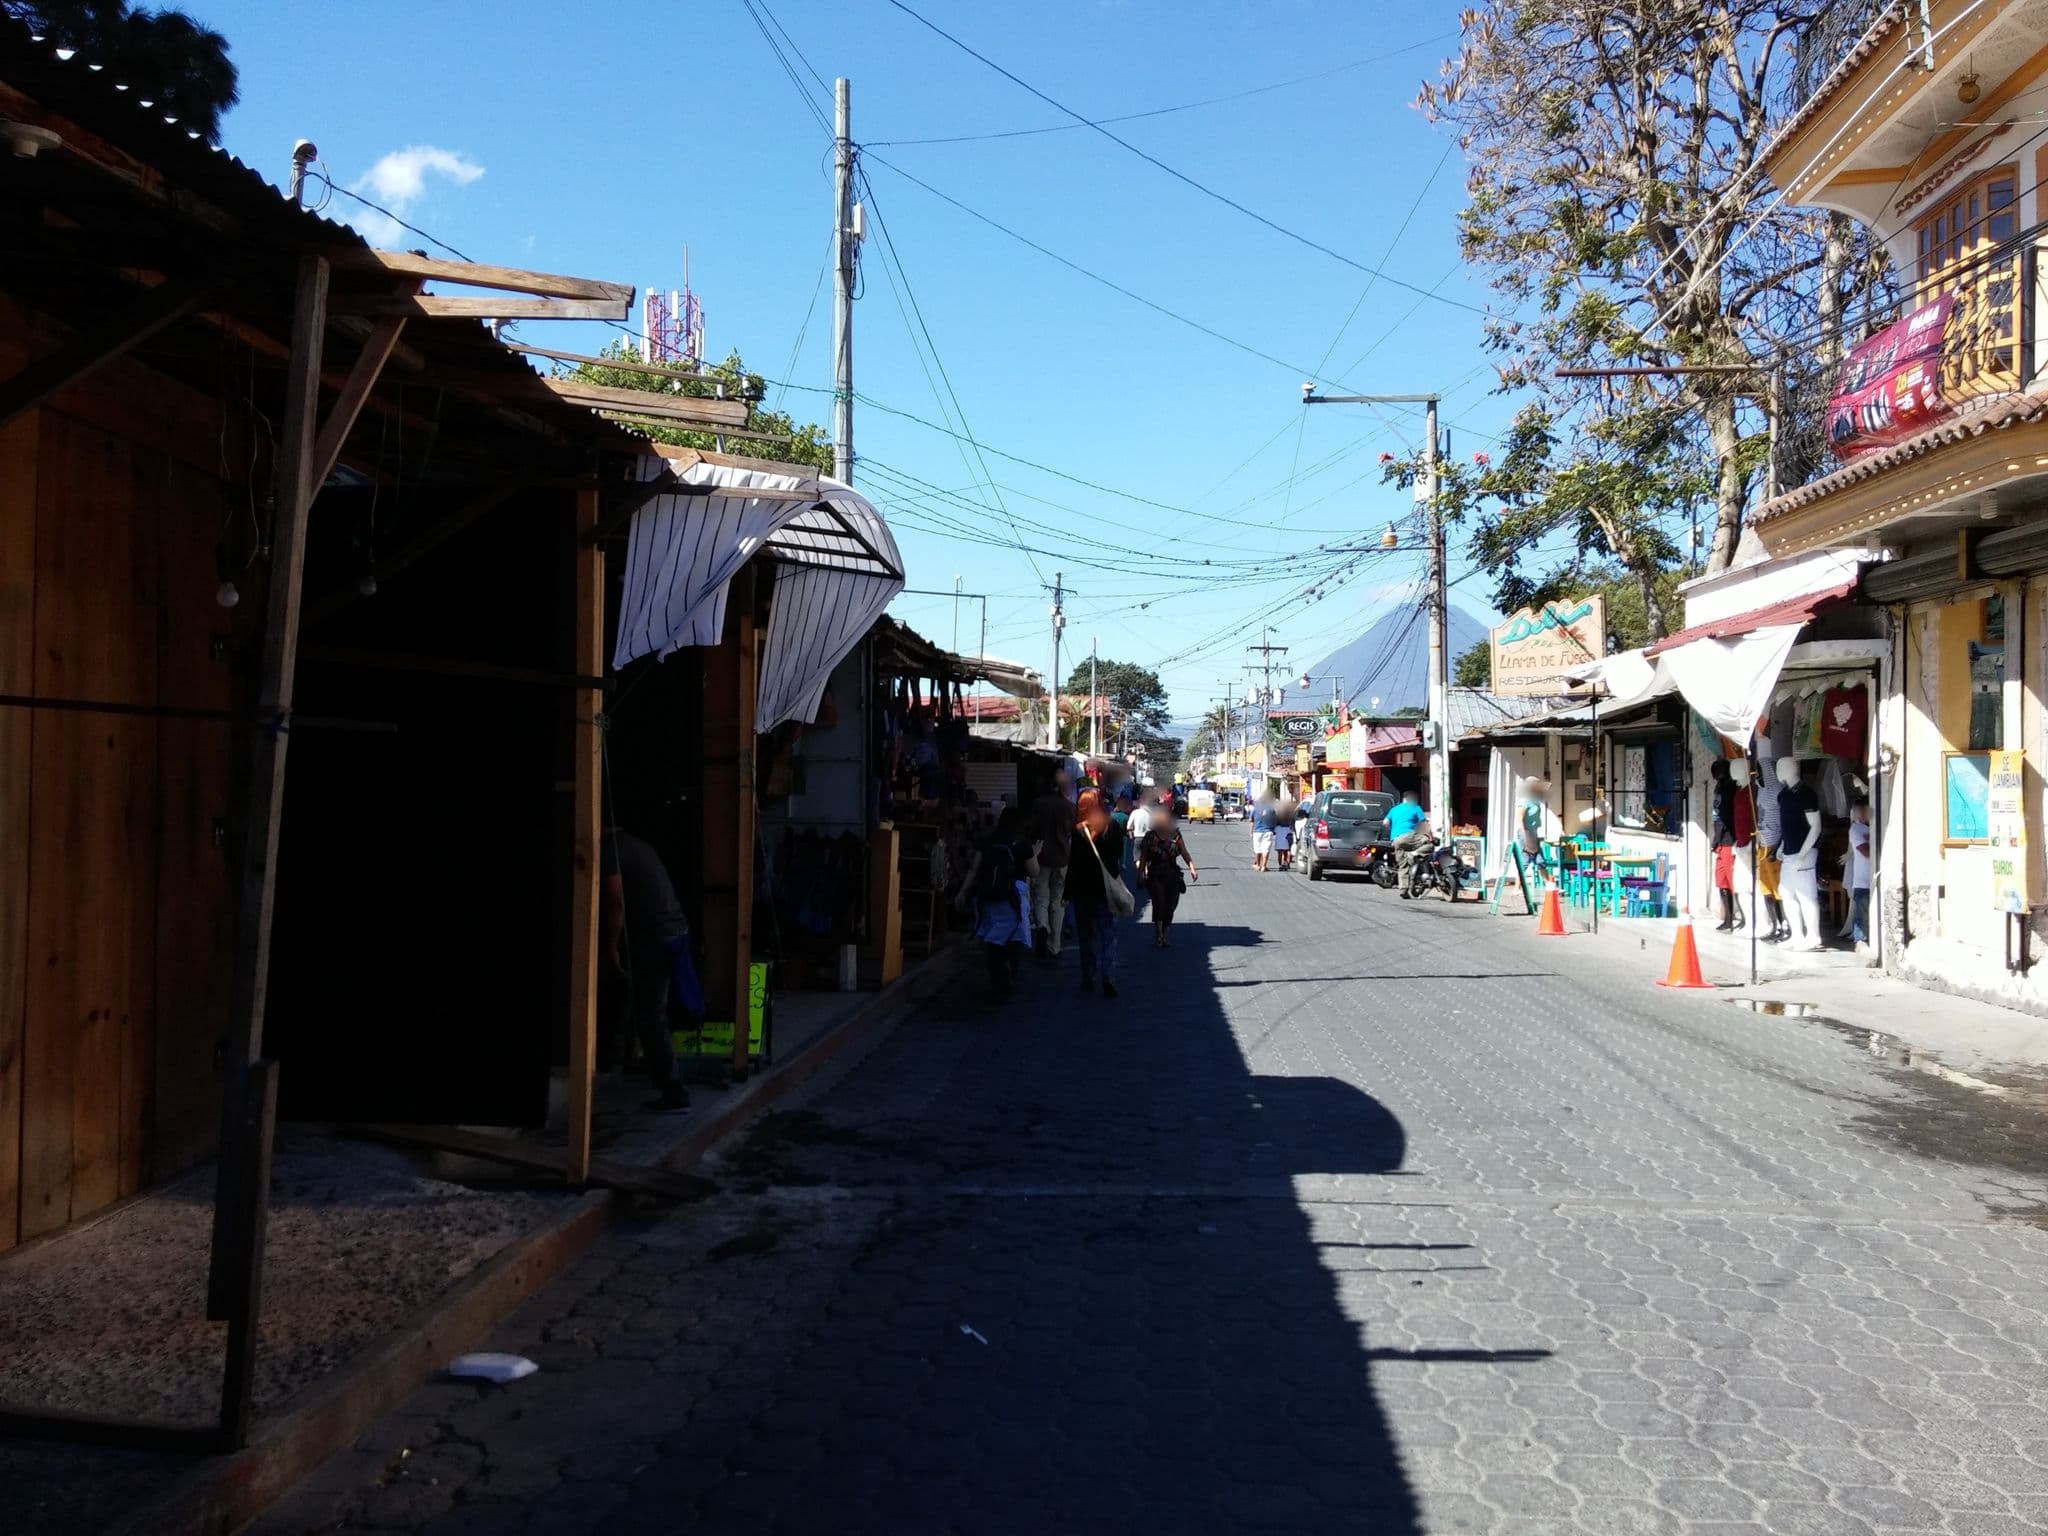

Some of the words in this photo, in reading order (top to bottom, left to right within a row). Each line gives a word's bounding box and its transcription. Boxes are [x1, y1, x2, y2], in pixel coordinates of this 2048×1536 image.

[1500, 654, 1536, 669] LLAMA
[1541, 655, 1555, 666] DE
[1288, 721, 1314, 731] REGIS
[1992, 773, 2020, 789] CAMBIAN
[1992, 859, 2013, 876] EUROS
